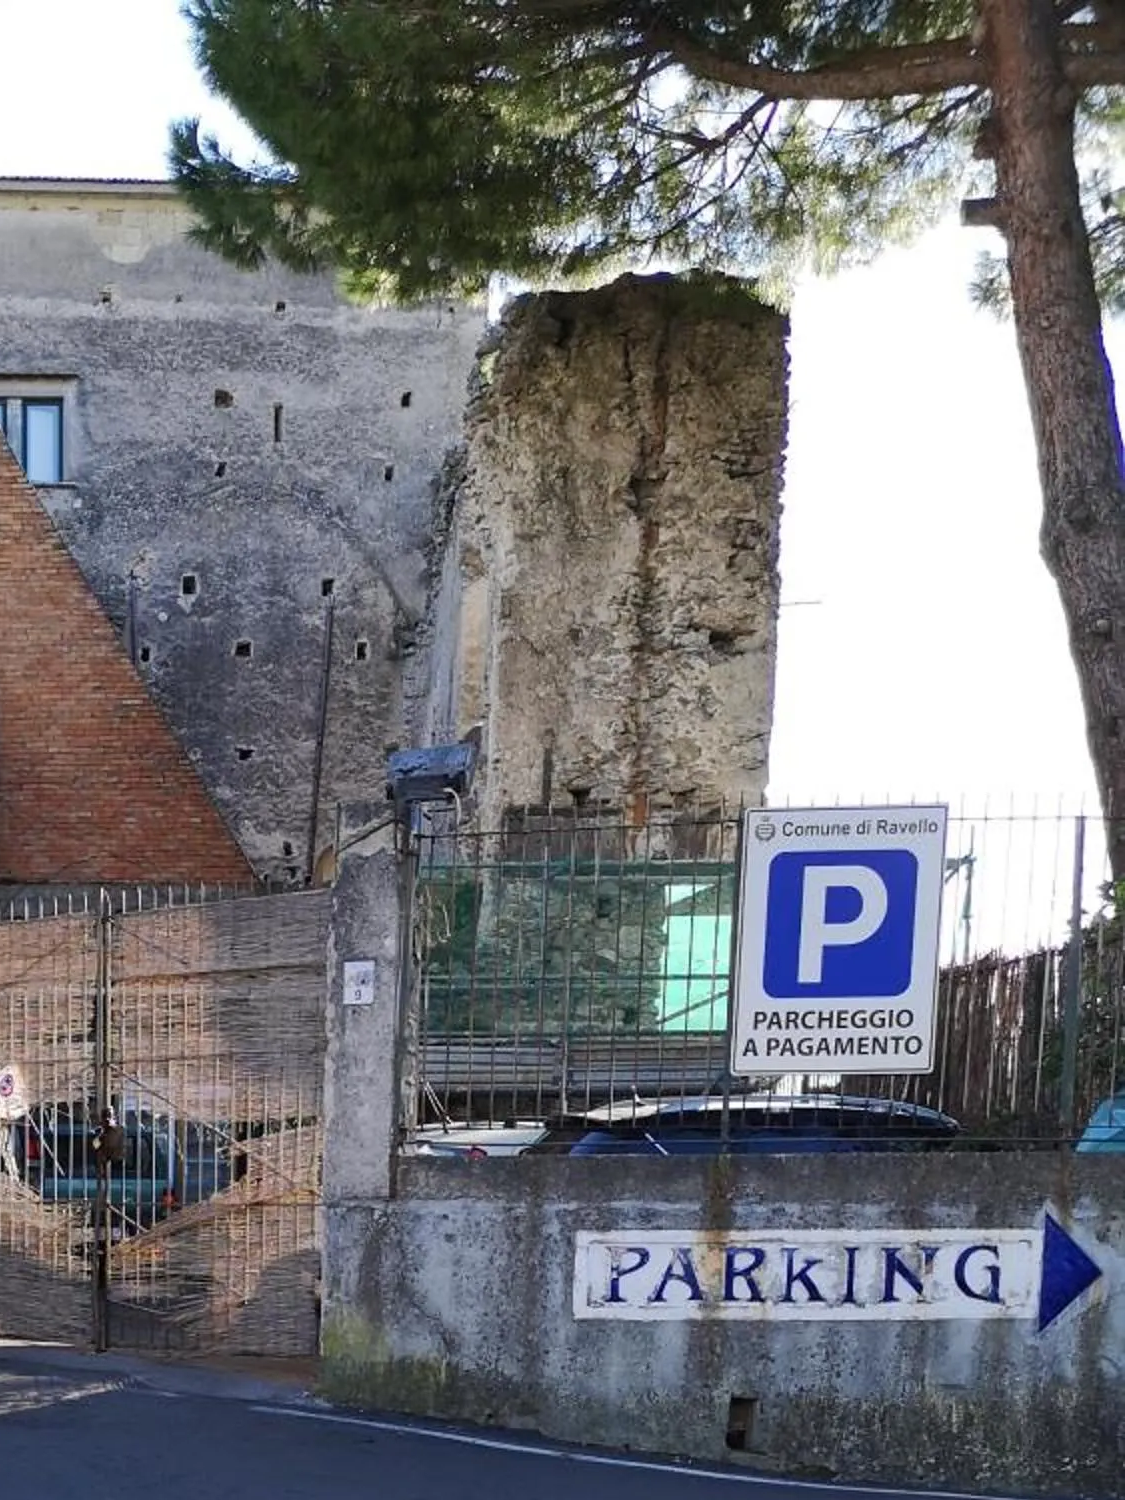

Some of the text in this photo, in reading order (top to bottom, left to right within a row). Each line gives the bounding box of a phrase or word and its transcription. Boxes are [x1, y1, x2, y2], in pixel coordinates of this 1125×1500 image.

[782, 818, 939, 838] Comune di Ravello
[797, 865, 888, 984] P
[752, 1009, 914, 1031] PARCHEGGIO
[742, 1035, 923, 1057] A PAGAMENTO
[605, 1244, 1005, 1305] PARKING
